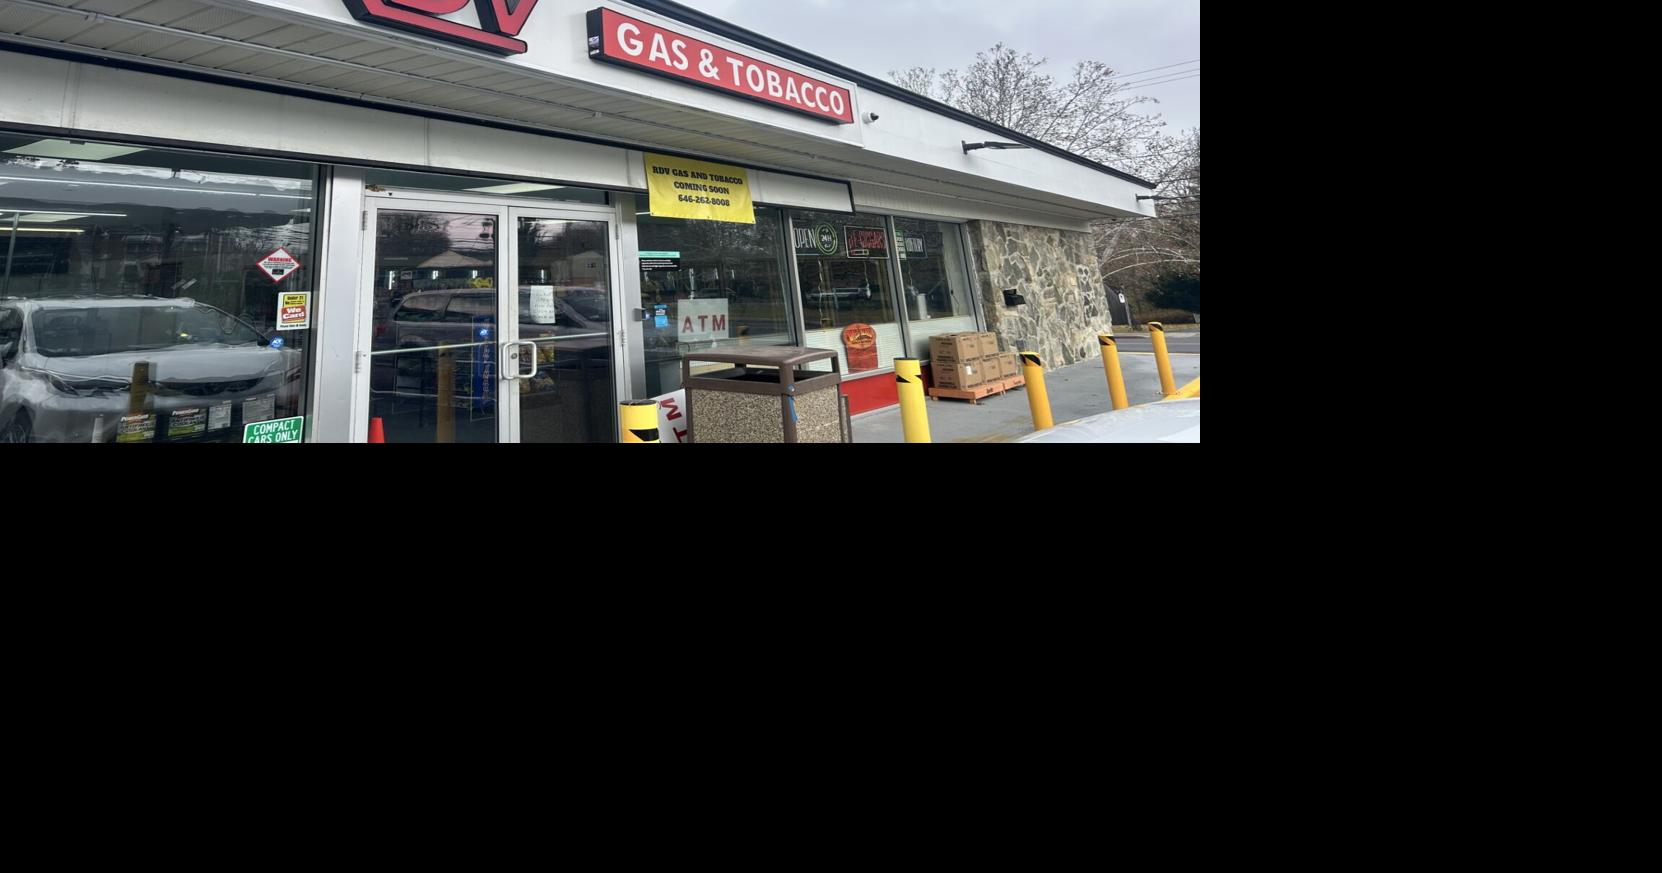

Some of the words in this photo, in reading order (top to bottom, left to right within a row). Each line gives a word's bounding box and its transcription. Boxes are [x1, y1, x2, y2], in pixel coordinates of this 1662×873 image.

[617, 22, 689, 71] GAS
[698, 48, 720, 81] &
[726, 56, 844, 115] TOBACCO
[652, 165, 670, 174] RDV
[672, 168, 689, 177] GAS
[690, 171, 708, 180] AND
[709, 173, 743, 185] TOBACCO
[673, 181, 707, 192] COMING
[709, 185, 730, 195] SOON
[678, 194, 730, 207] 646-262-8008
[794, 227, 817, 249] OPEN
[282, 311, 305, 320] Card
[682, 314, 726, 333] ATM
[253, 420, 295, 435] COMPACT
[660, 397, 688, 444] TM
[248, 433, 272, 444] CARS
[275, 430, 298, 442] ONLY
